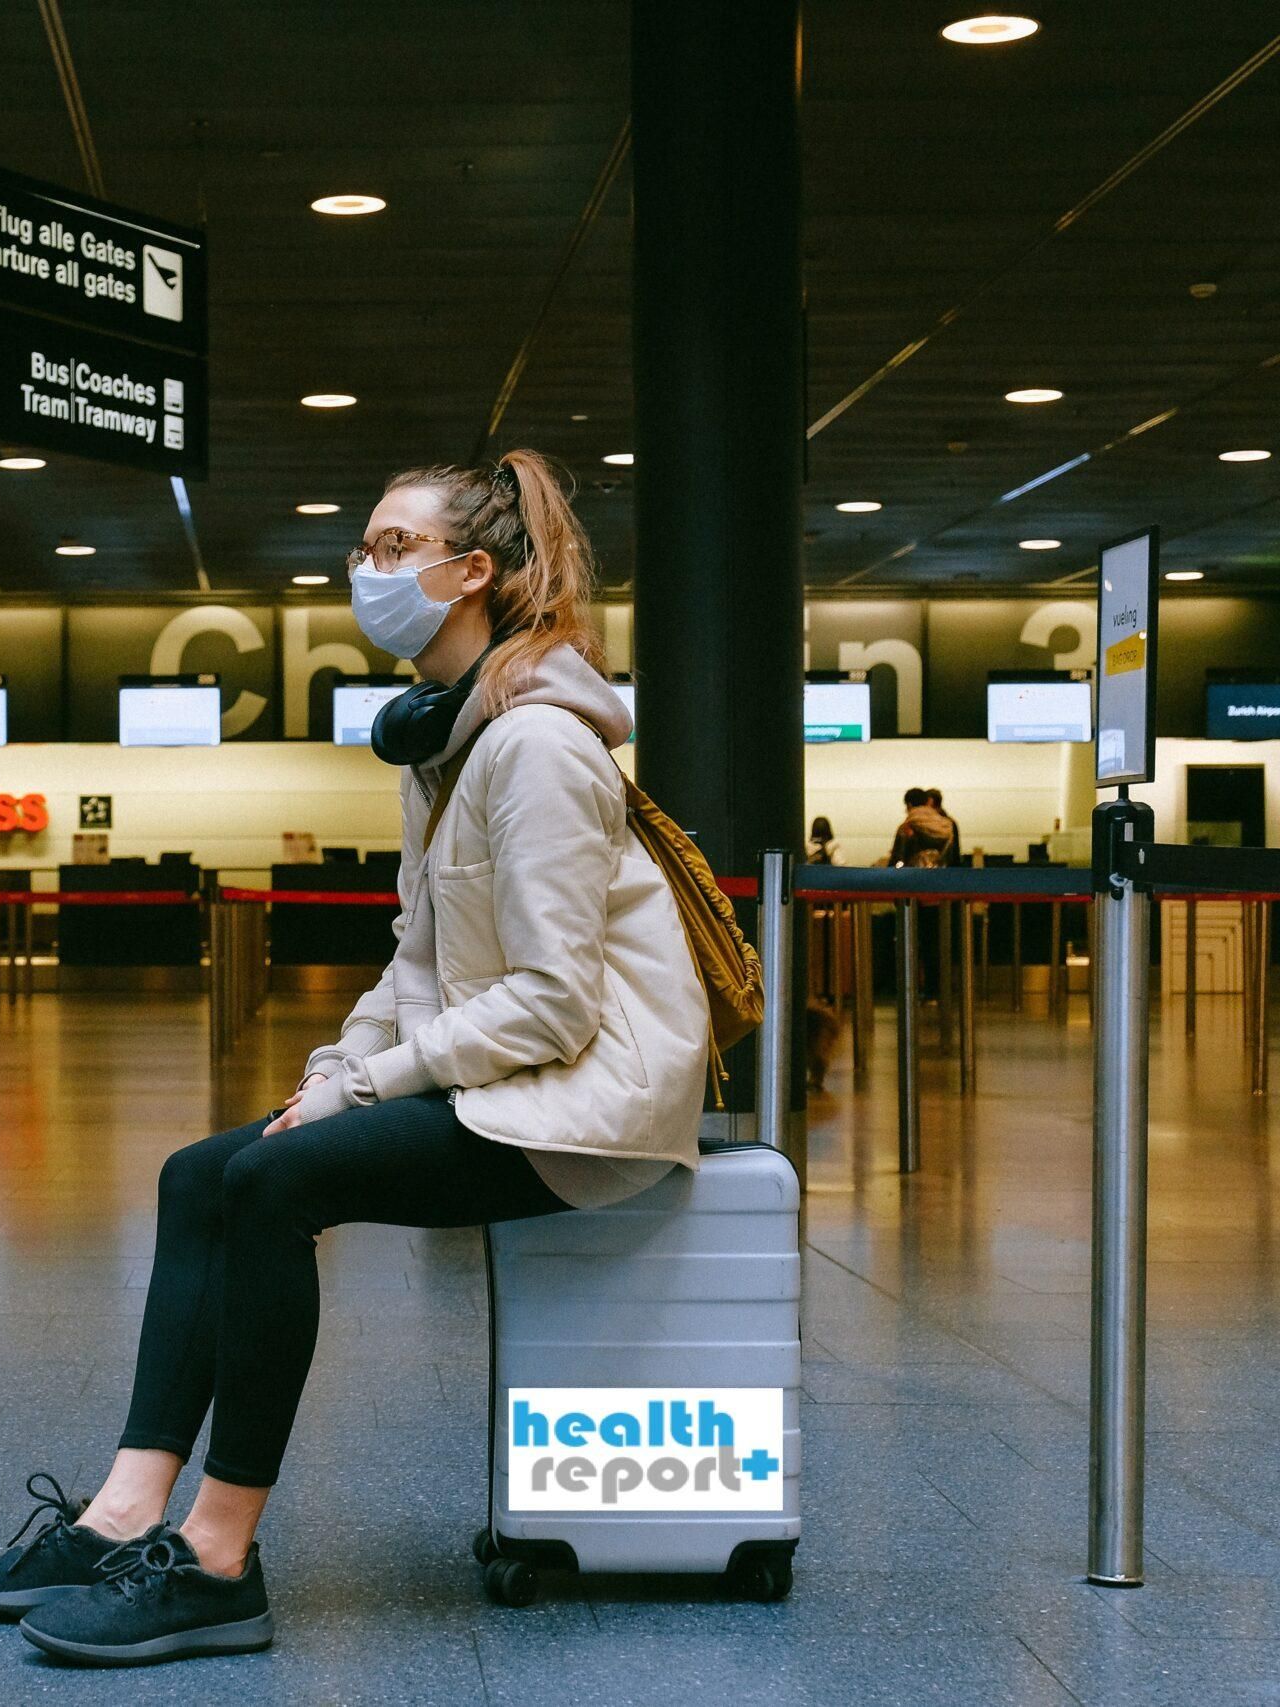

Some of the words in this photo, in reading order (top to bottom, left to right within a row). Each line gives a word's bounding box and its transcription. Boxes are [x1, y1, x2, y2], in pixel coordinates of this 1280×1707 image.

[39, 222, 75, 252] alle
[80, 231, 136, 271] Gates
[55, 261, 79, 288] all
[84, 272, 136, 303] gates
[1113, 605, 1137, 628] vueling
